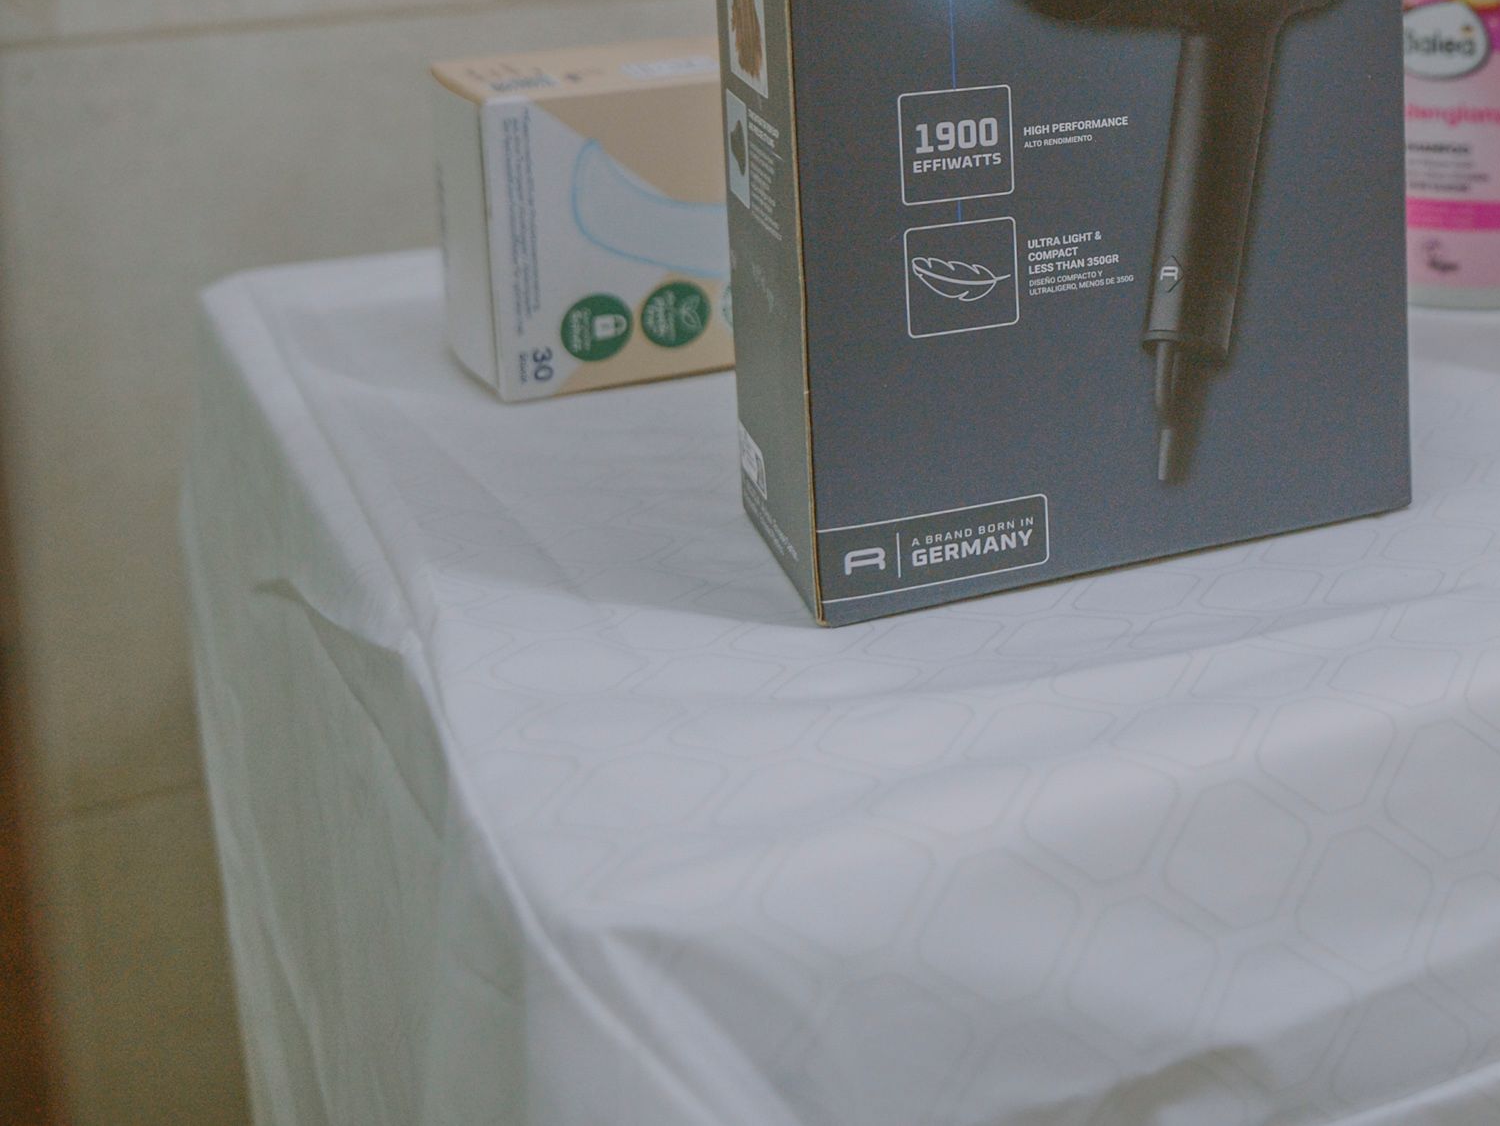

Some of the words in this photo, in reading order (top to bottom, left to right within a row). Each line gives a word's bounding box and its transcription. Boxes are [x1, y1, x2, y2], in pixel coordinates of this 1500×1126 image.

[915, 117, 998, 154] 1900
[1023, 124, 1050, 136] HIGH
[1052, 116, 1129, 134] PERFORMANCE
[1024, 138, 1043, 148] ALTO
[1043, 134, 1093, 146] RENDIMIENTO
[913, 152, 1002, 174] EFFIWATTS
[1027, 236, 1061, 249] ULTRA
[1062, 232, 1093, 245] LIGHT
[1094, 231, 1102, 241] &
[1027, 246, 1079, 262] COMPACT
[1028, 263, 1054, 275] LESS
[1056, 258, 1085, 272] THAN
[1087, 254, 1119, 267] 350GR
[1028, 276, 1056, 287] DISEÑO
[1057, 271, 1097, 283] COMPACTO
[1079, 279, 1105, 289] MENOS
[1105, 277, 1115, 285] DE
[1116, 274, 1134, 284] 350G
[532, 347, 555, 382] 30
[911, 537, 920, 547] A
[925, 528, 973, 545] BRAND
[978, 520, 1015, 535] BORN
[1020, 516, 1034, 526] IN
[911, 528, 1033, 567] GERMANY
